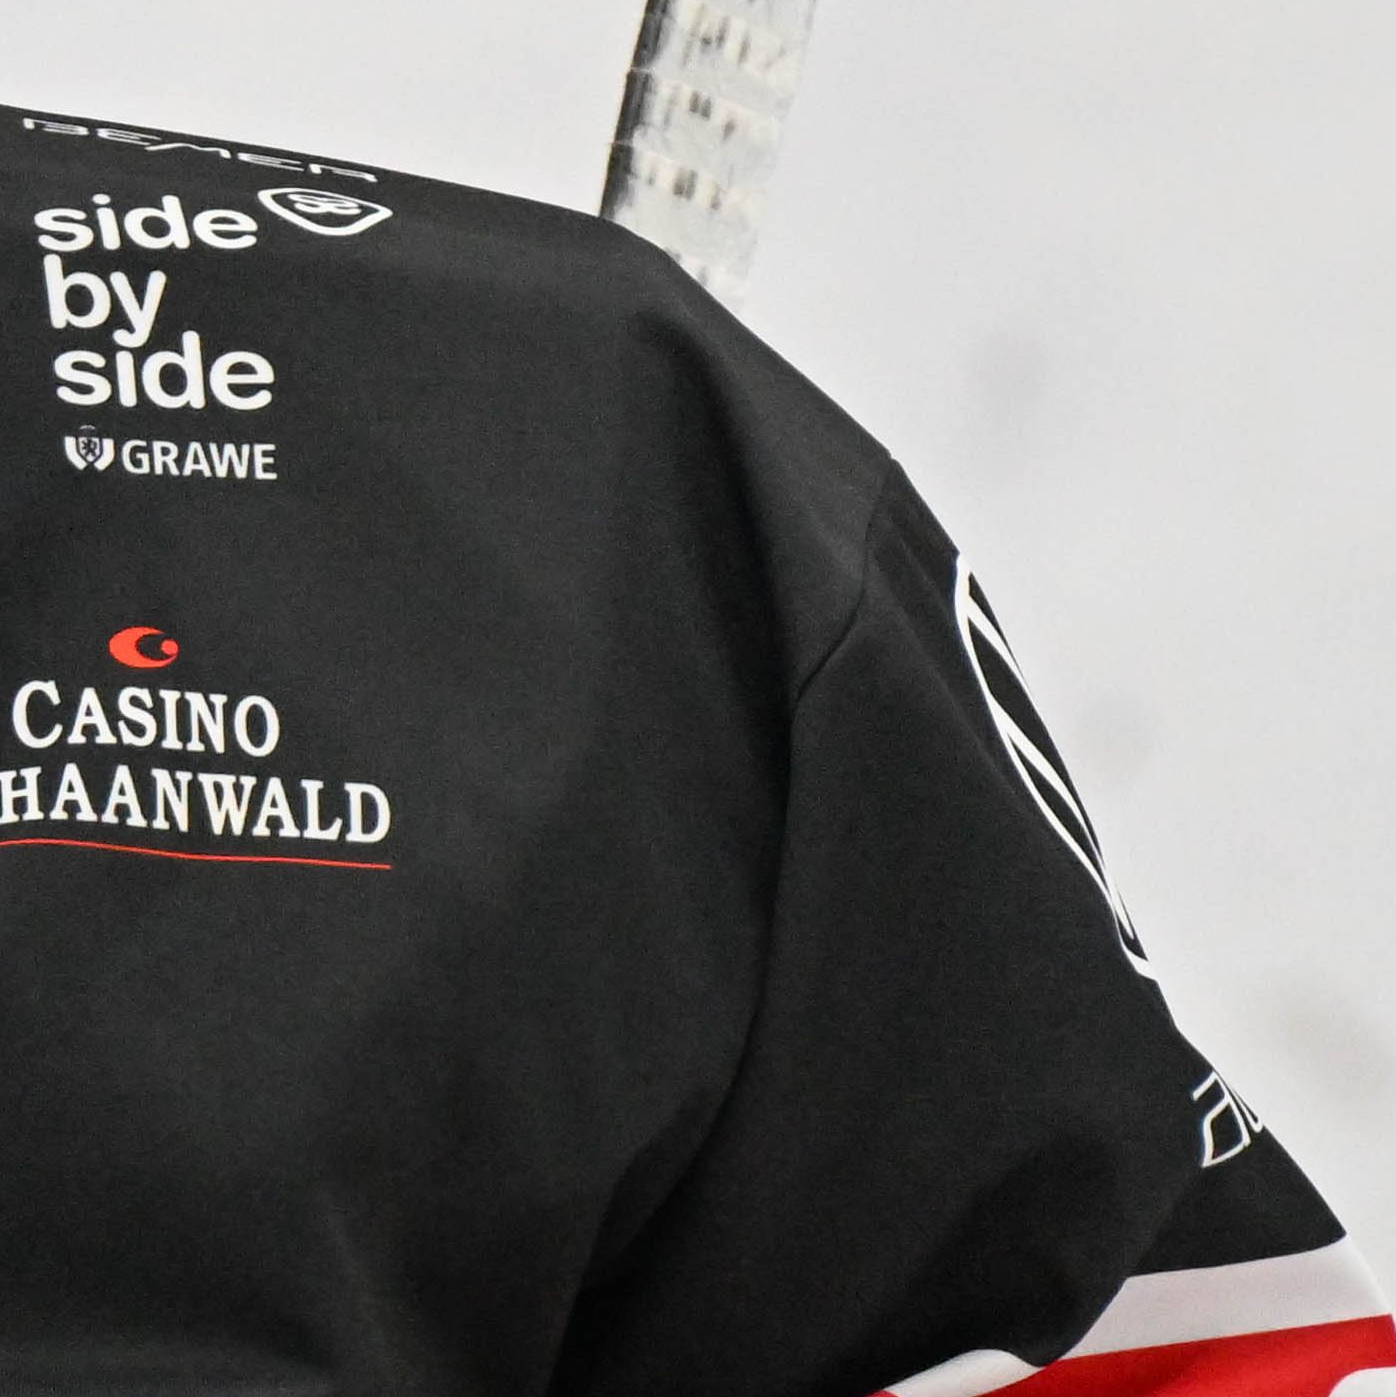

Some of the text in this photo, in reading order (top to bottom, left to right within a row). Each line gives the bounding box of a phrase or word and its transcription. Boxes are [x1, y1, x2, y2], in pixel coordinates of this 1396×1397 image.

[33, 193, 259, 252] side
[42, 253, 168, 349] by
[53, 330, 276, 412] side
[121, 438, 278, 482] GRAWE
[11, 679, 282, 758] CASINO
